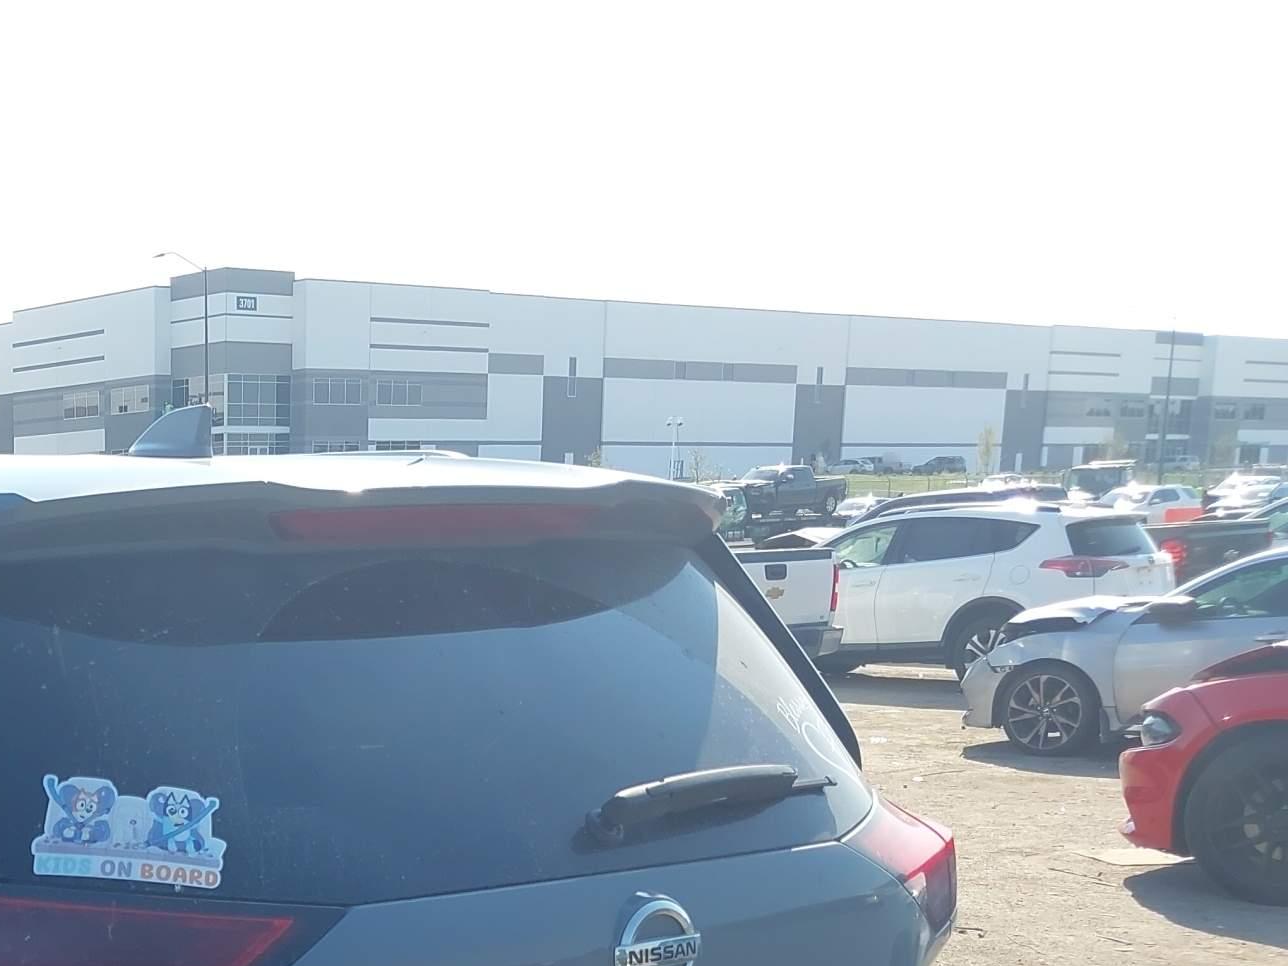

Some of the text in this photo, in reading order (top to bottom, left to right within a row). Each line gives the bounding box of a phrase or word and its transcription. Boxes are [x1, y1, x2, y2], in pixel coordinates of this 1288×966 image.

[239, 298, 255, 309] 3701
[35, 853, 219, 887] KIDS ON BOARD
[628, 939, 697, 965] NISSAN
